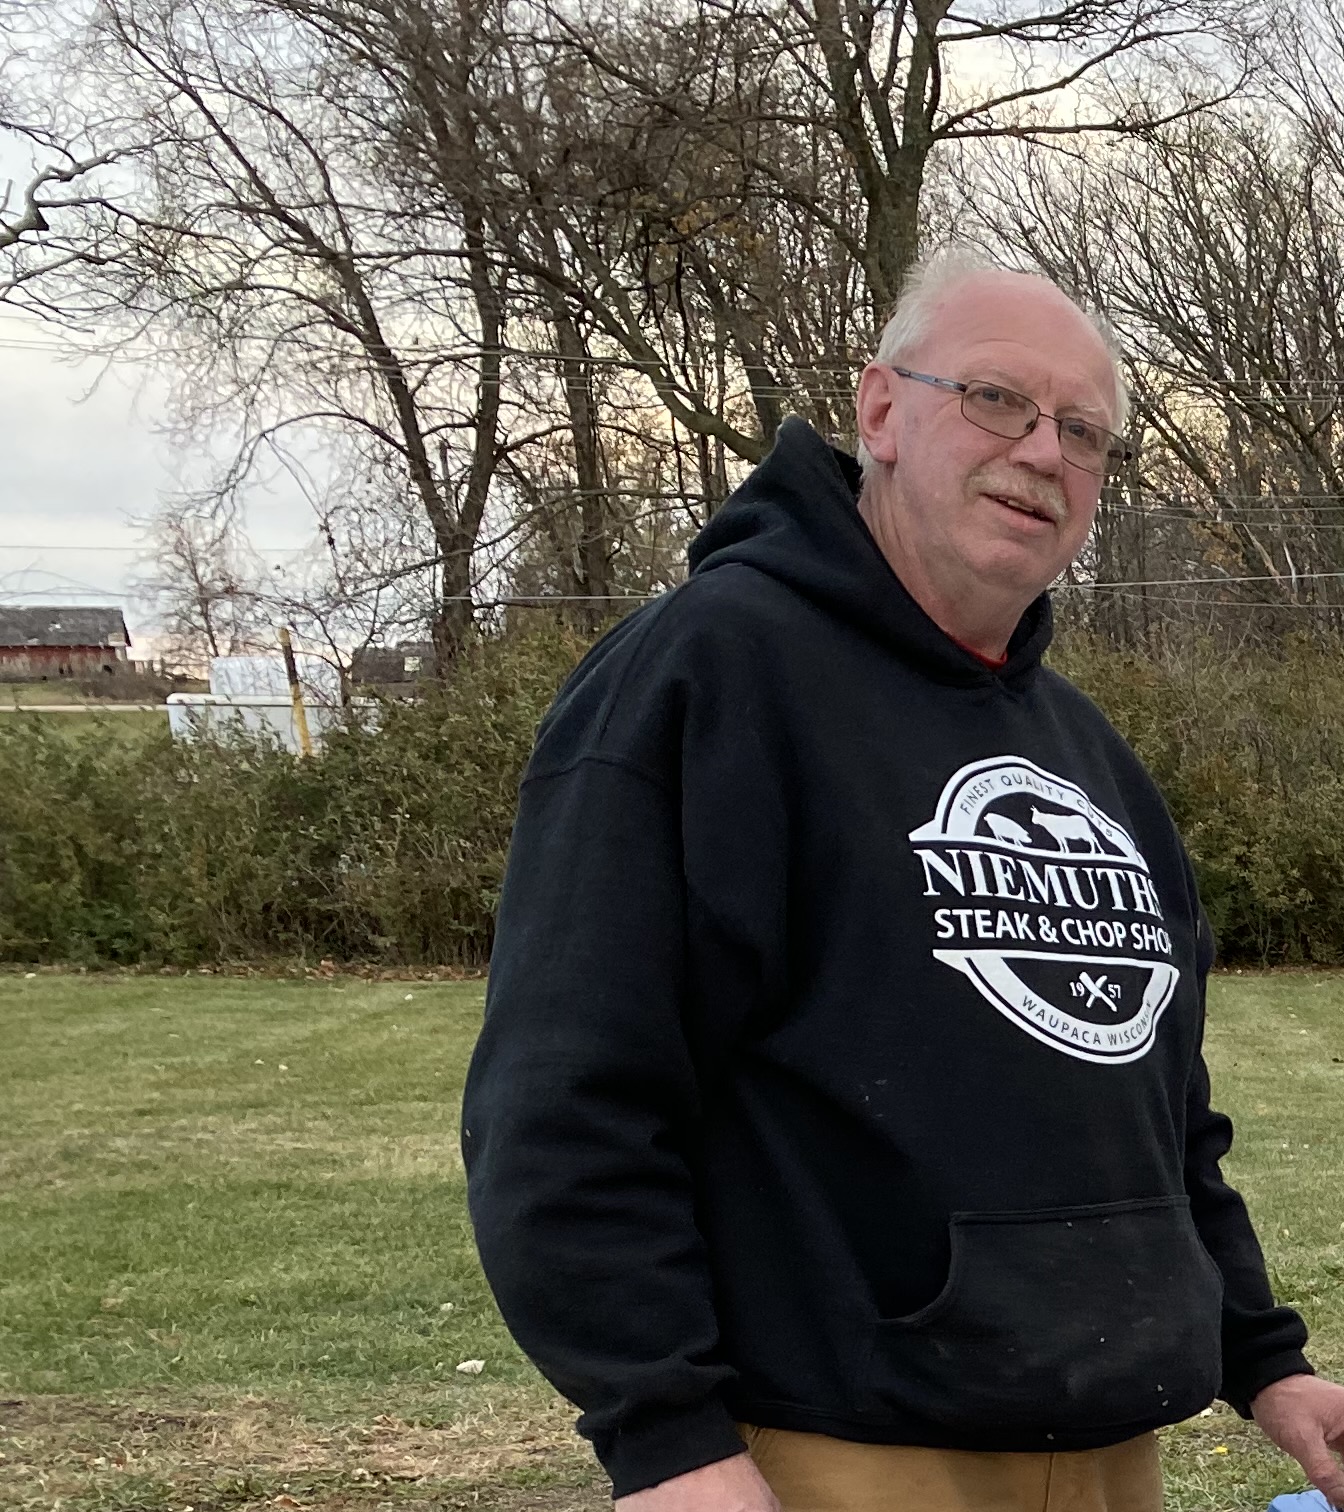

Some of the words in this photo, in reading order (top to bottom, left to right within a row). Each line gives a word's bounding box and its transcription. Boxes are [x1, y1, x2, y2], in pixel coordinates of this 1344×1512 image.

[960, 778, 996, 815] FINEST
[1001, 773, 1064, 801] QUALITY
[934, 908, 1037, 941] STEAK
[1038, 915, 1060, 943] &
[1061, 918, 1127, 948] CHOP
[1069, 982, 1085, 997] 19
[1108, 984, 1122, 999] 57
[1022, 995, 1101, 1046] WAUPACA
